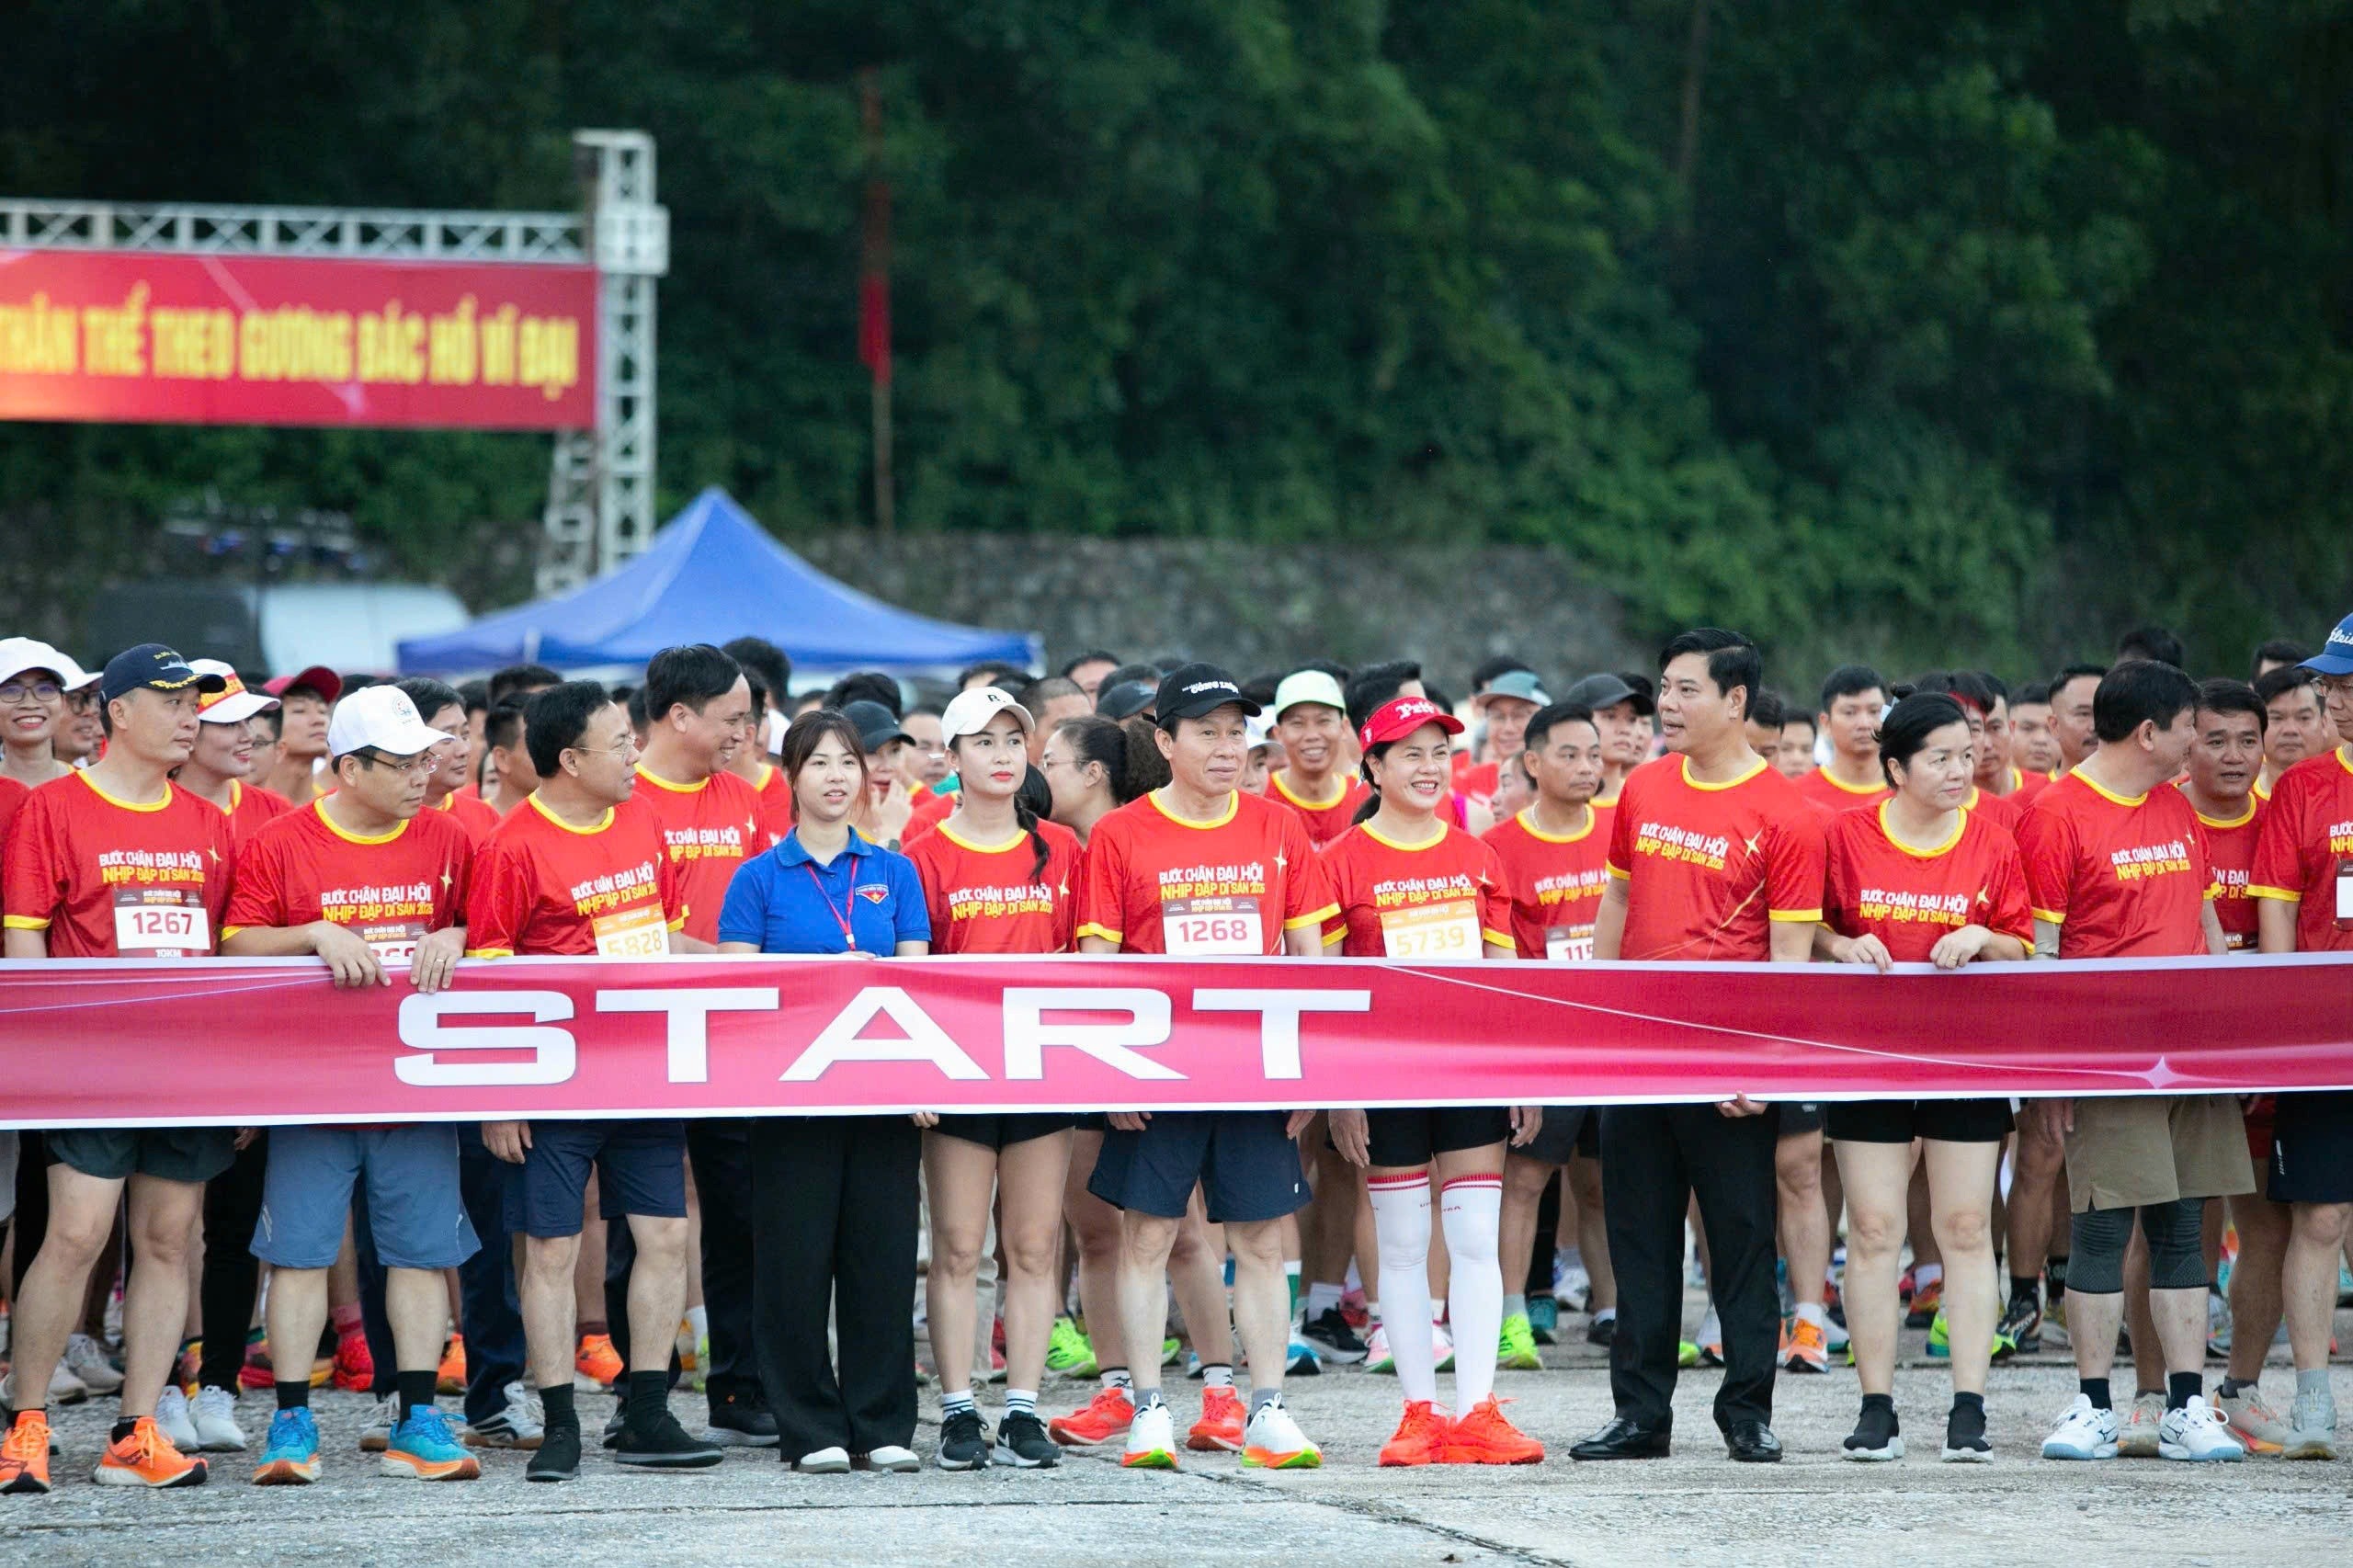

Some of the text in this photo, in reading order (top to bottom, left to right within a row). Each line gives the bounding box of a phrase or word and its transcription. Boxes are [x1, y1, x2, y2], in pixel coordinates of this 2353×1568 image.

[151, 309, 233, 380] THEO
[358, 297, 426, 383] BÁC
[349, 886, 380, 903] CHÂN
[382, 885, 404, 904] ĐẠI
[407, 882, 431, 903] HỘI
[1885, 892, 1917, 907] CHÂN
[132, 911, 192, 935] 1267
[1178, 919, 1247, 942] 1268
[1396, 926, 1465, 956] 5739
[394, 986, 1371, 1086] START
